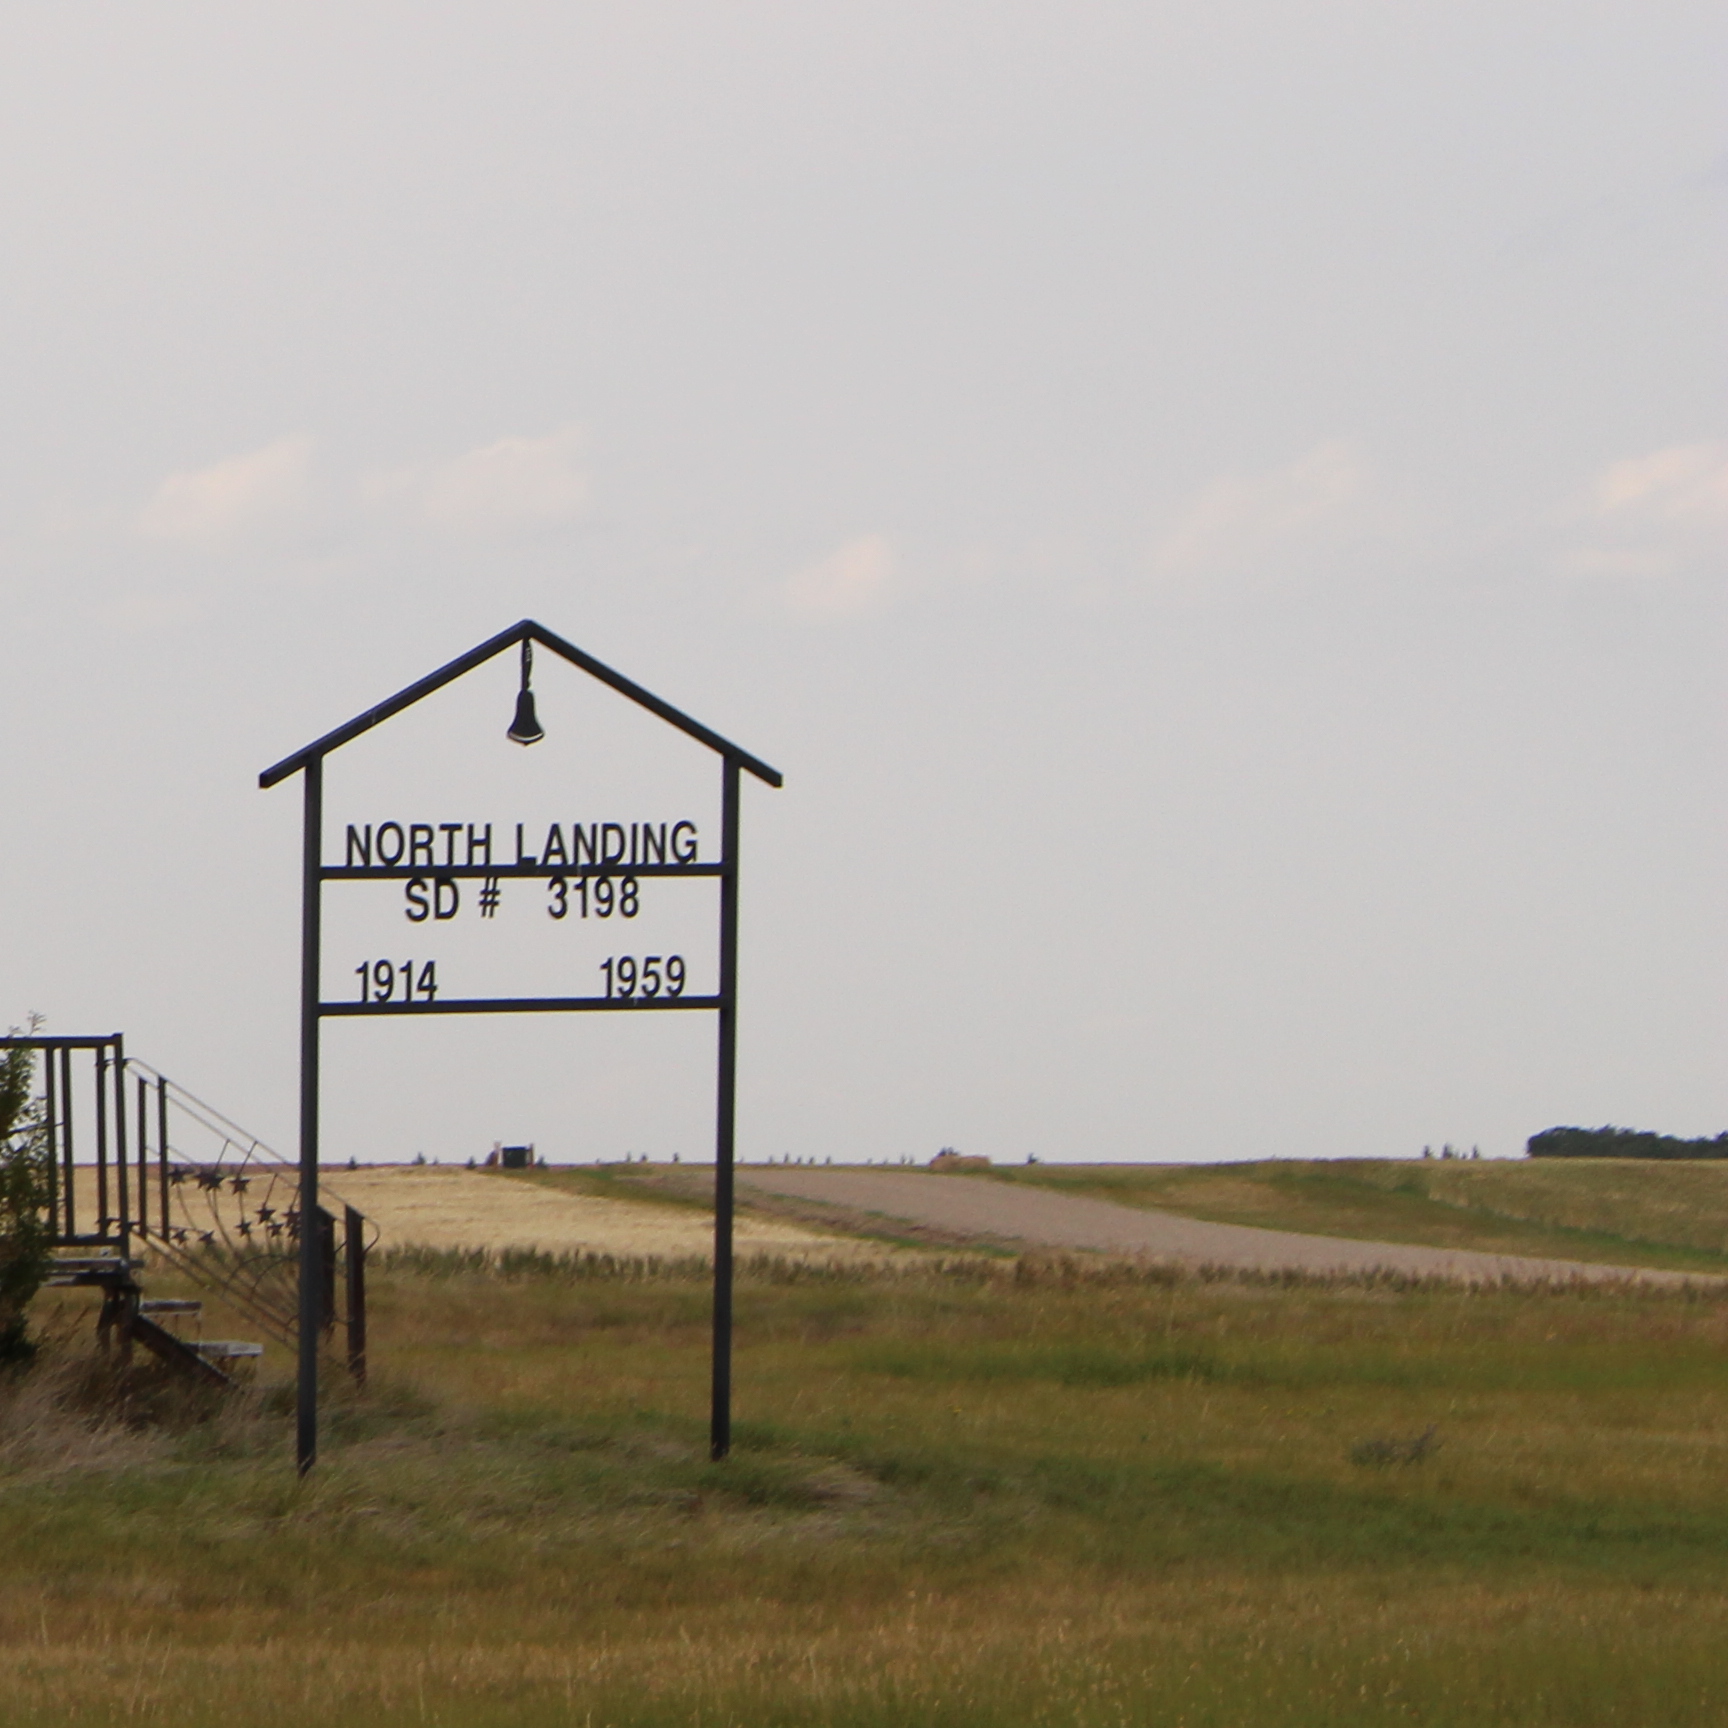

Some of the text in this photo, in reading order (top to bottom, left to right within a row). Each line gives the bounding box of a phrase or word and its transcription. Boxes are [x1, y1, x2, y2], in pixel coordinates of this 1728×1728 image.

[346, 820, 699, 866] NORTH LANDING
[405, 876, 640, 921] SD # 3198
[356, 956, 686, 1002] 1914 1959
